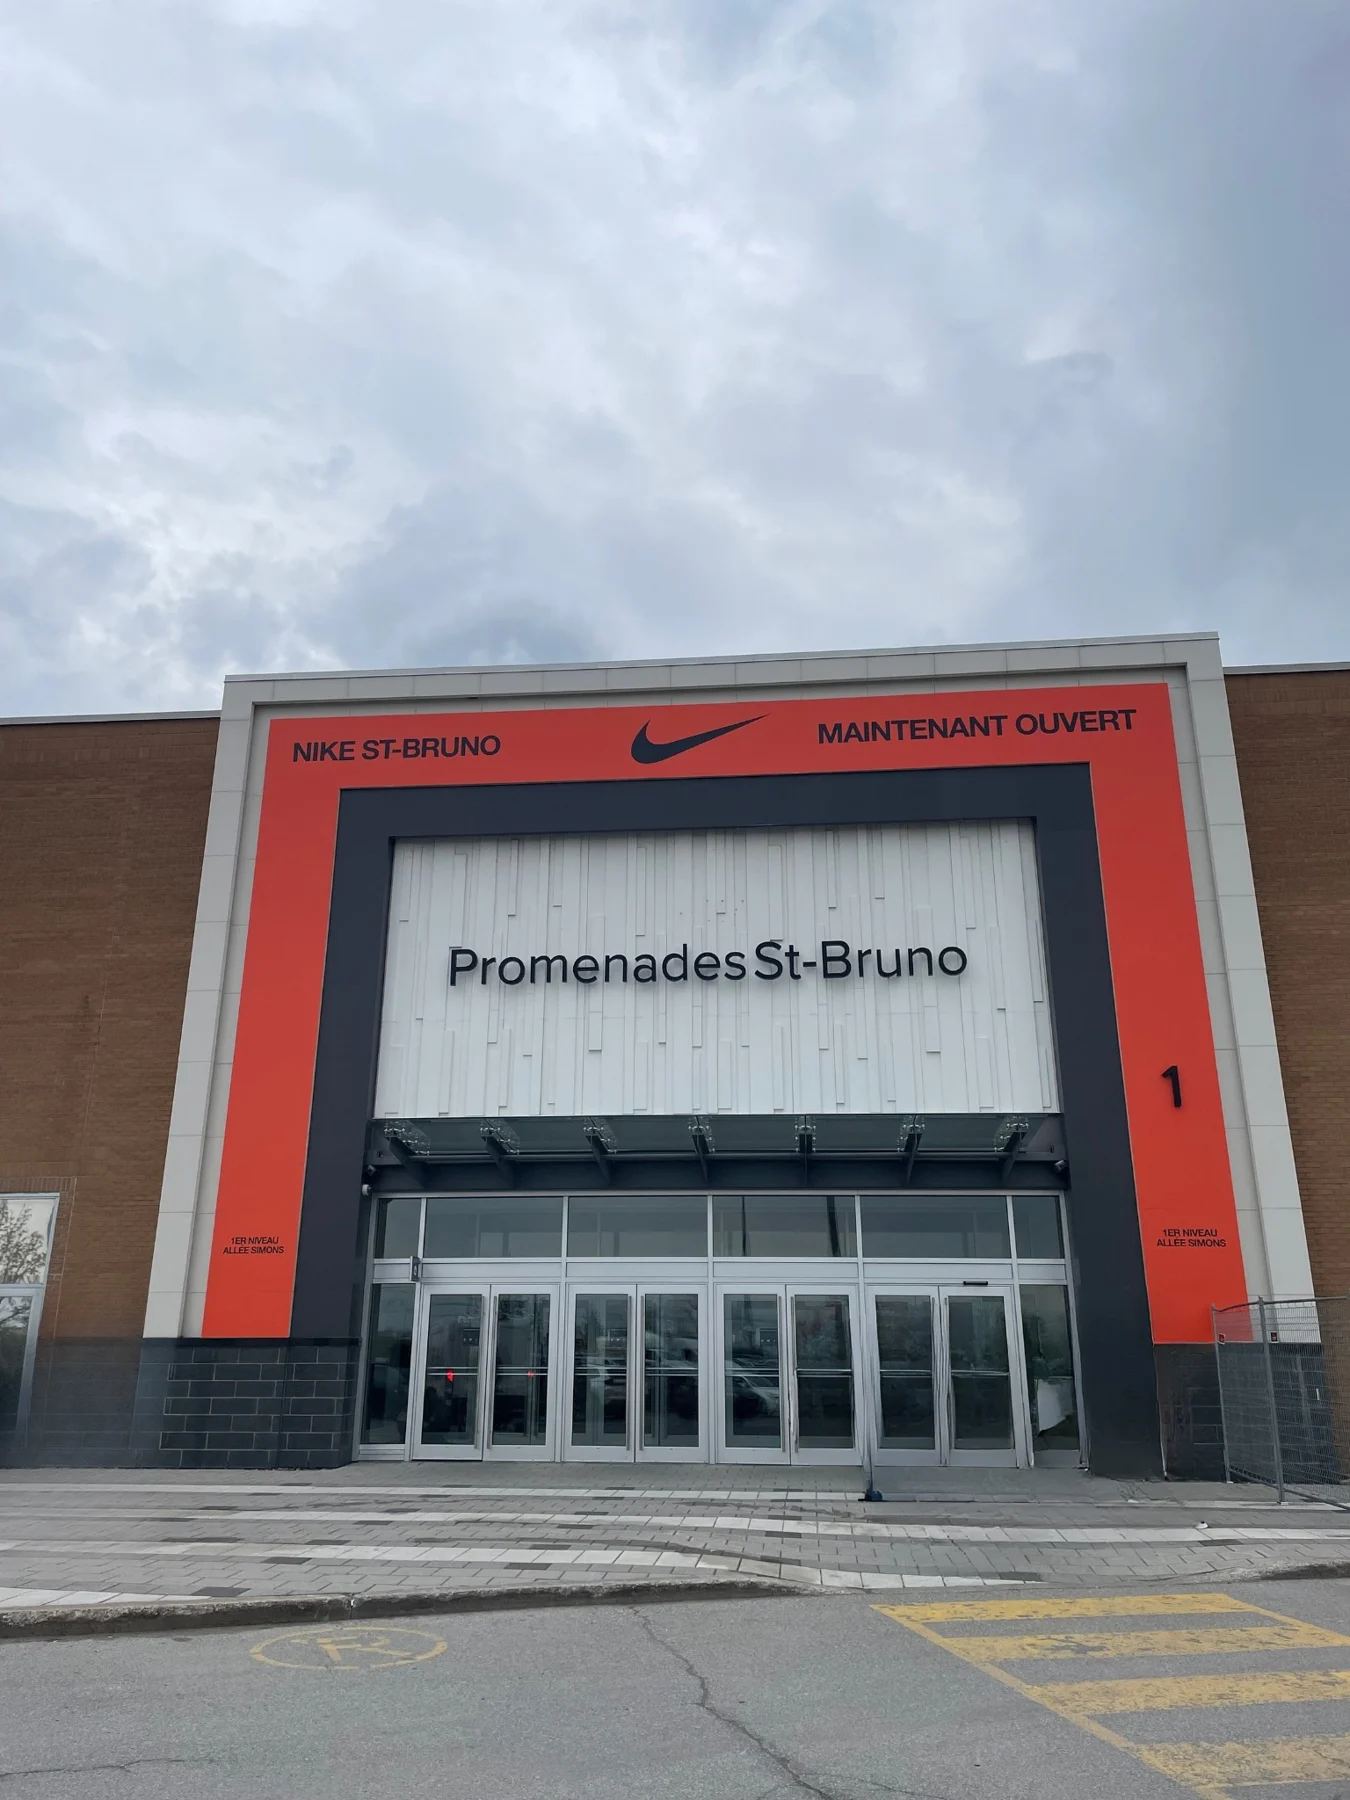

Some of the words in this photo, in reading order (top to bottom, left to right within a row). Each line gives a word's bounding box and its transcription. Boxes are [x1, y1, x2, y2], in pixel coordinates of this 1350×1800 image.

[818, 714, 1008, 744] MAINTENANT
[1014, 709, 1137, 736] OUVERT
[293, 741, 355, 762] NIKE
[361, 735, 501, 760] ST-BRUNO
[1161, 1065, 1182, 1108] 1
[1163, 1228, 1180, 1237] 1ER
[1183, 1228, 1217, 1237] NIVEAU
[251, 1246, 284, 1254] SIMONS
[1188, 1239, 1226, 1247] SIMONS
